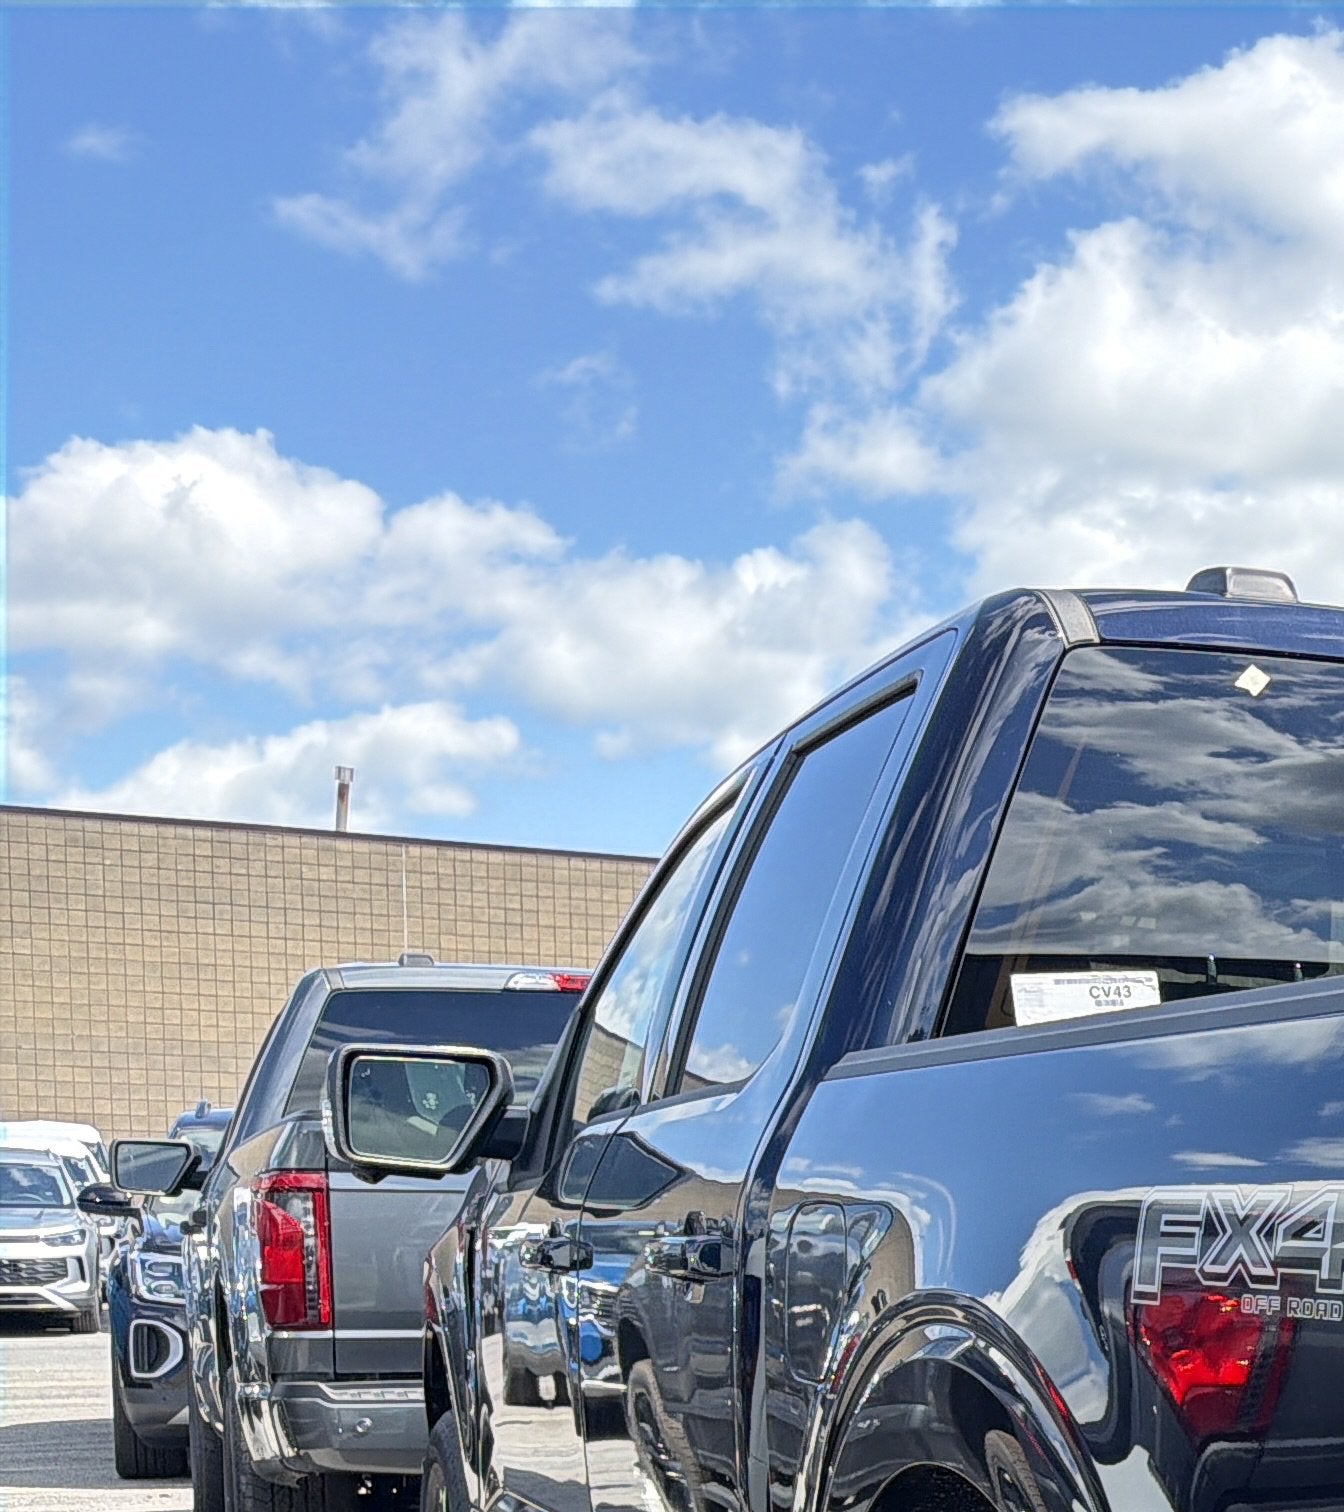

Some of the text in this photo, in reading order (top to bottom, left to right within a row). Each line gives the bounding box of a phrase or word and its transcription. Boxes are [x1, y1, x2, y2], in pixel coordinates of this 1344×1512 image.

[1088, 985, 1132, 999] CV43
[1241, 1294, 1344, 1321] OFF ROAD
